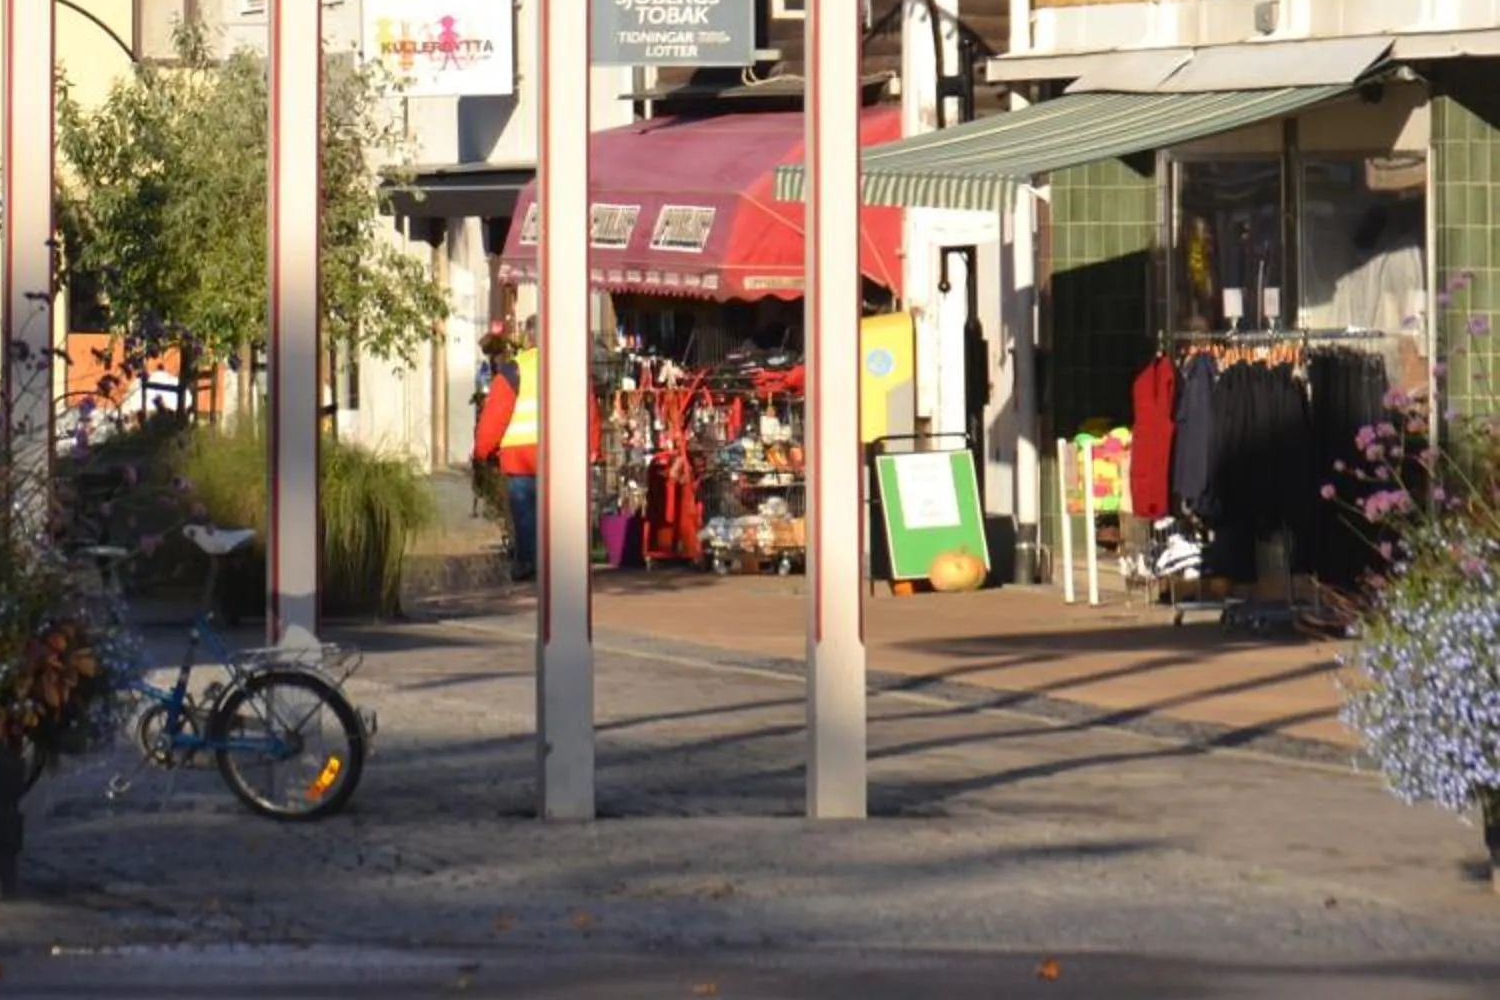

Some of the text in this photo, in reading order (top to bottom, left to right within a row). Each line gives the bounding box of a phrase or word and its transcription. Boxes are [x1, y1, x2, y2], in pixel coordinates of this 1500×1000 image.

[634, 6, 709, 24] TOBAK
[618, 31, 694, 44] TIDNINGAR
[645, 45, 698, 58] LOTTER
